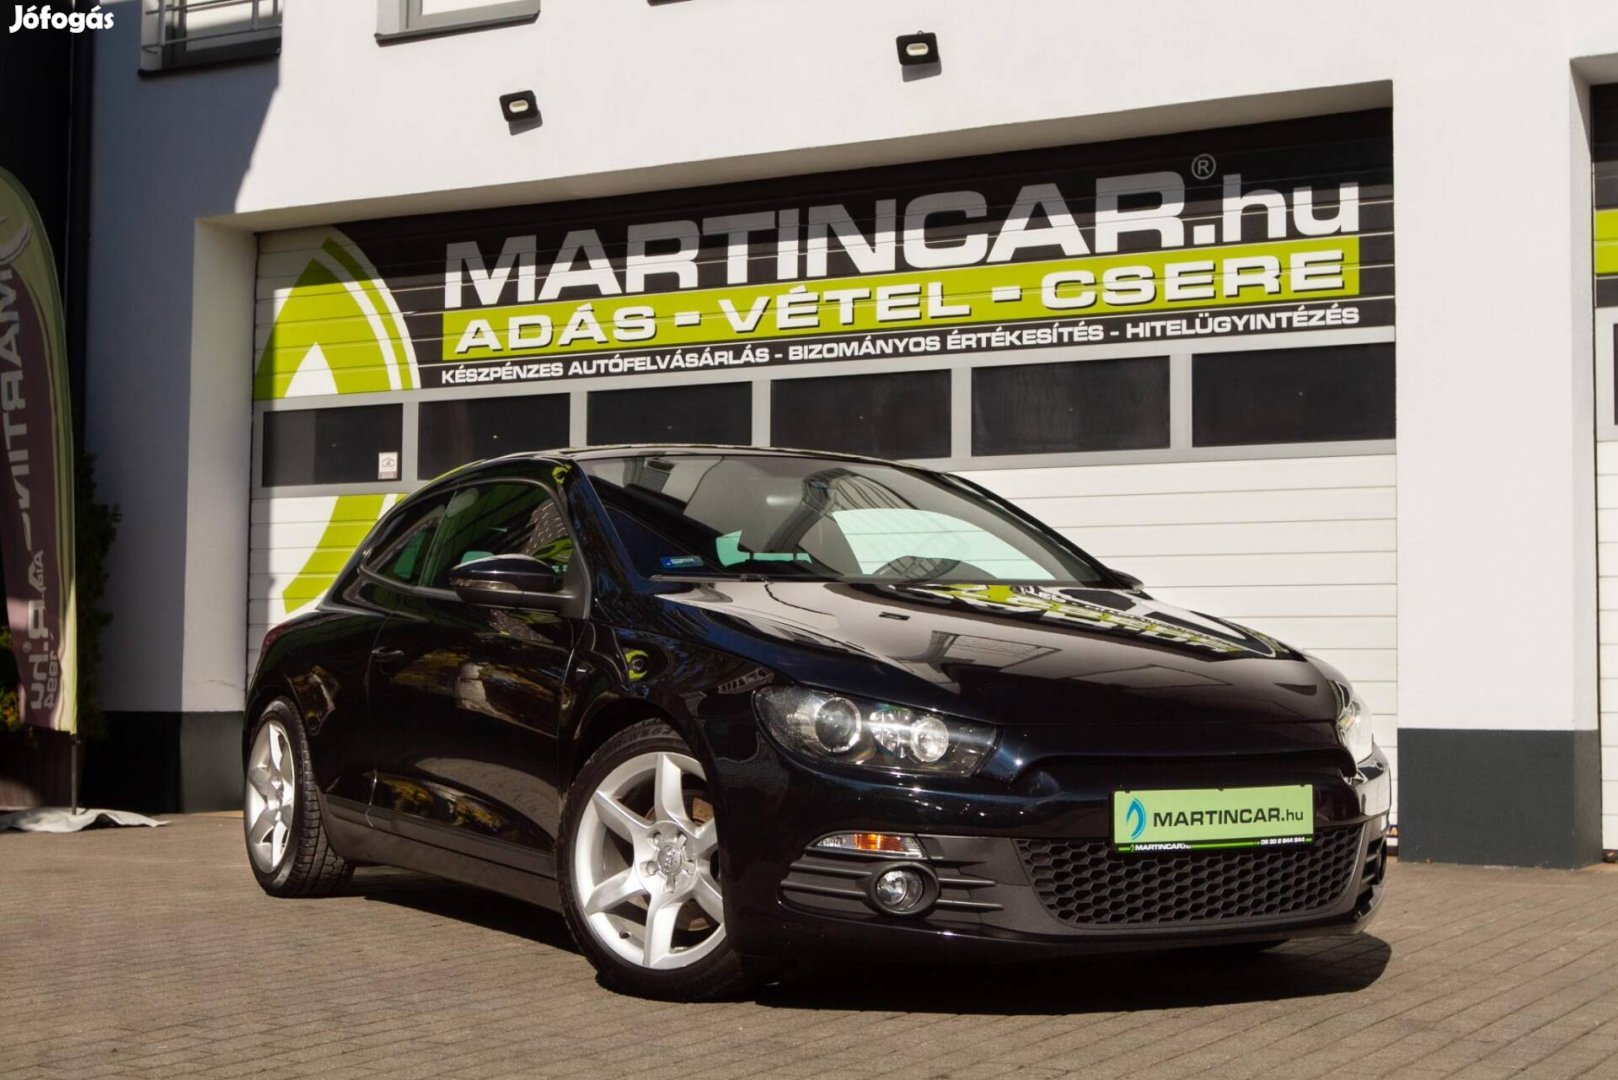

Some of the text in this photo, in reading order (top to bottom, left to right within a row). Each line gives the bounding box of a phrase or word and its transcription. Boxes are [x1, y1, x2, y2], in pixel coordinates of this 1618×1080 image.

[455, 249, 1344, 354] ADÁS - VÉTEL - CSERE
[441, 361, 564, 385] KÉSZPÉNZES
[568, 345, 770, 376] AUTÓFELVÁSÁRLÁS
[788, 335, 941, 361] BIZOMÁNYOS
[946, 320, 1105, 351] ÉRTÉKESÍTÉS
[1126, 304, 1360, 339] HITELÜGYINTÉZÉS
[1153, 807, 1304, 827] MARTINCAR.hu
